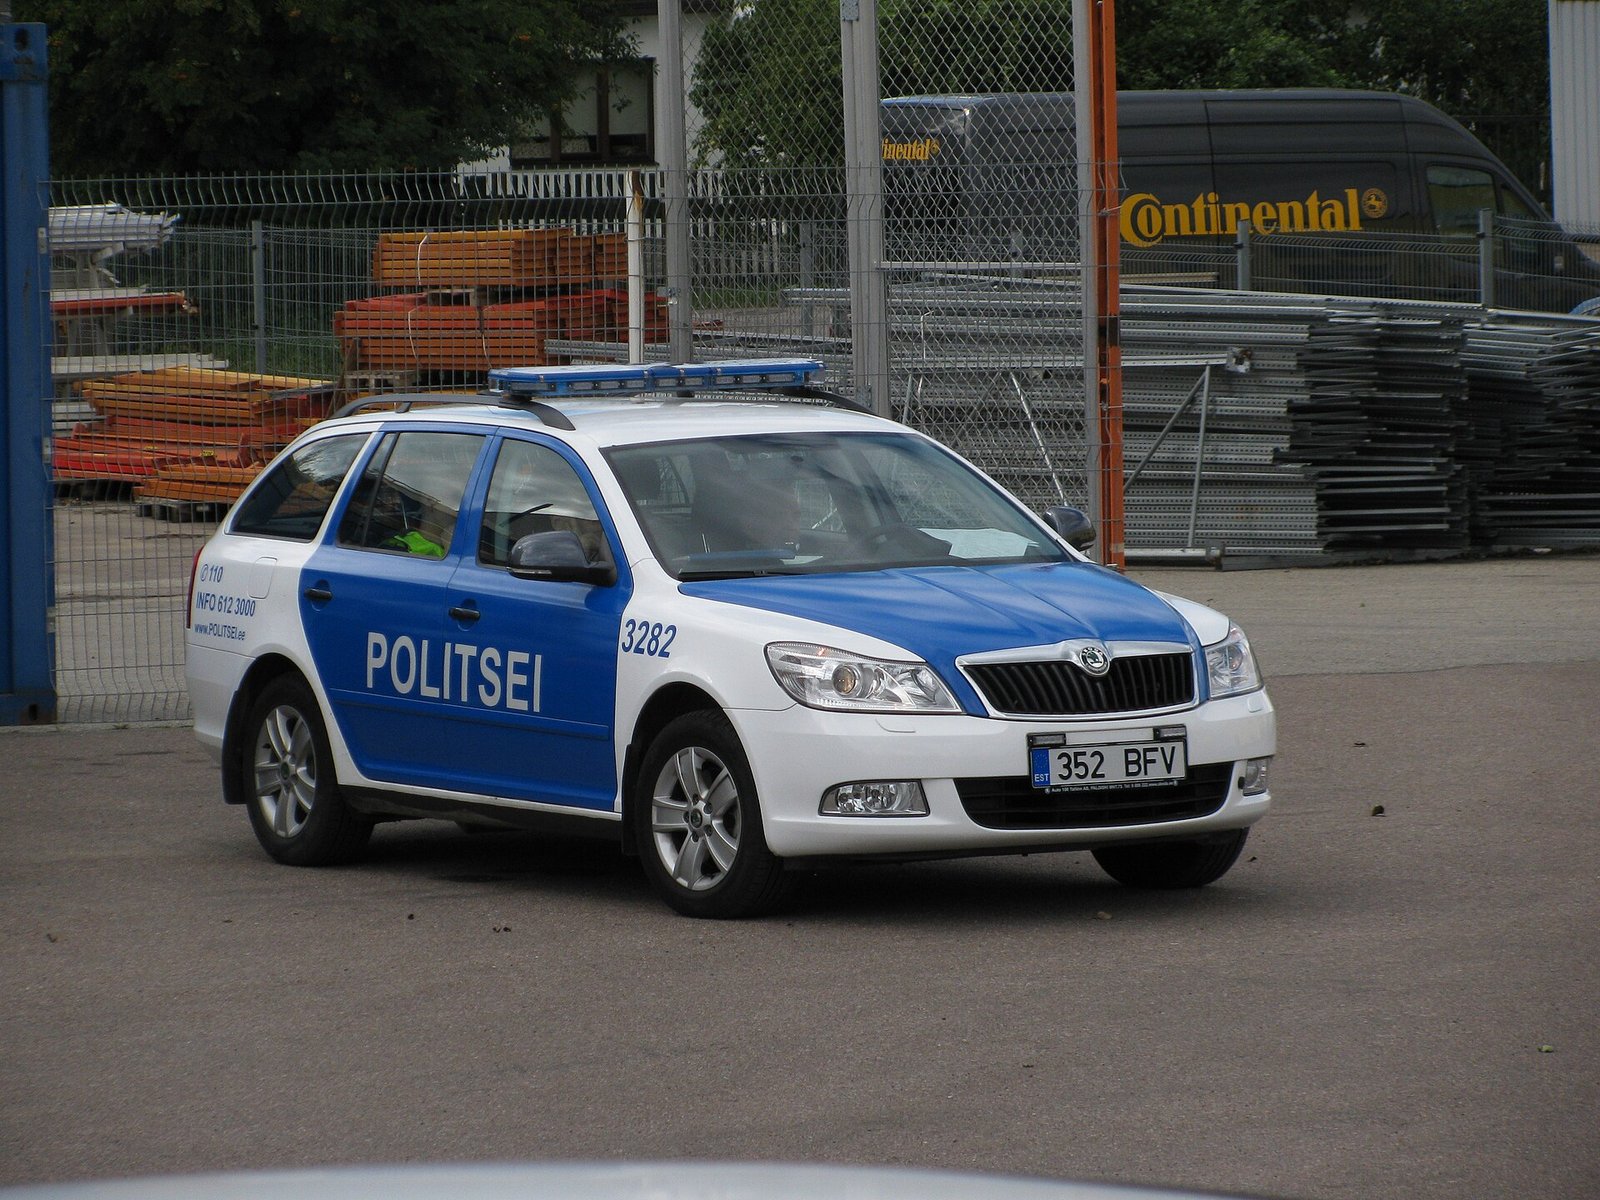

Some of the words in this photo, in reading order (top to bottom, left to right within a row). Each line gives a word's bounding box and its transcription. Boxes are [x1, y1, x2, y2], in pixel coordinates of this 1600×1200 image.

[1119, 188, 1363, 248] Continental
[209, 566, 223, 583] 110
[196, 592, 216, 611] INFO
[217, 595, 234, 614] 612
[234, 598, 256, 617] 3000
[195, 623, 245, 640] www.POLITSEI.ee
[621, 618, 677, 659] 3282
[366, 631, 542, 713] POLITSEI
[1034, 773, 1050, 783] EST
[1057, 751, 1106, 781] 352
[1124, 746, 1177, 778] BFV
